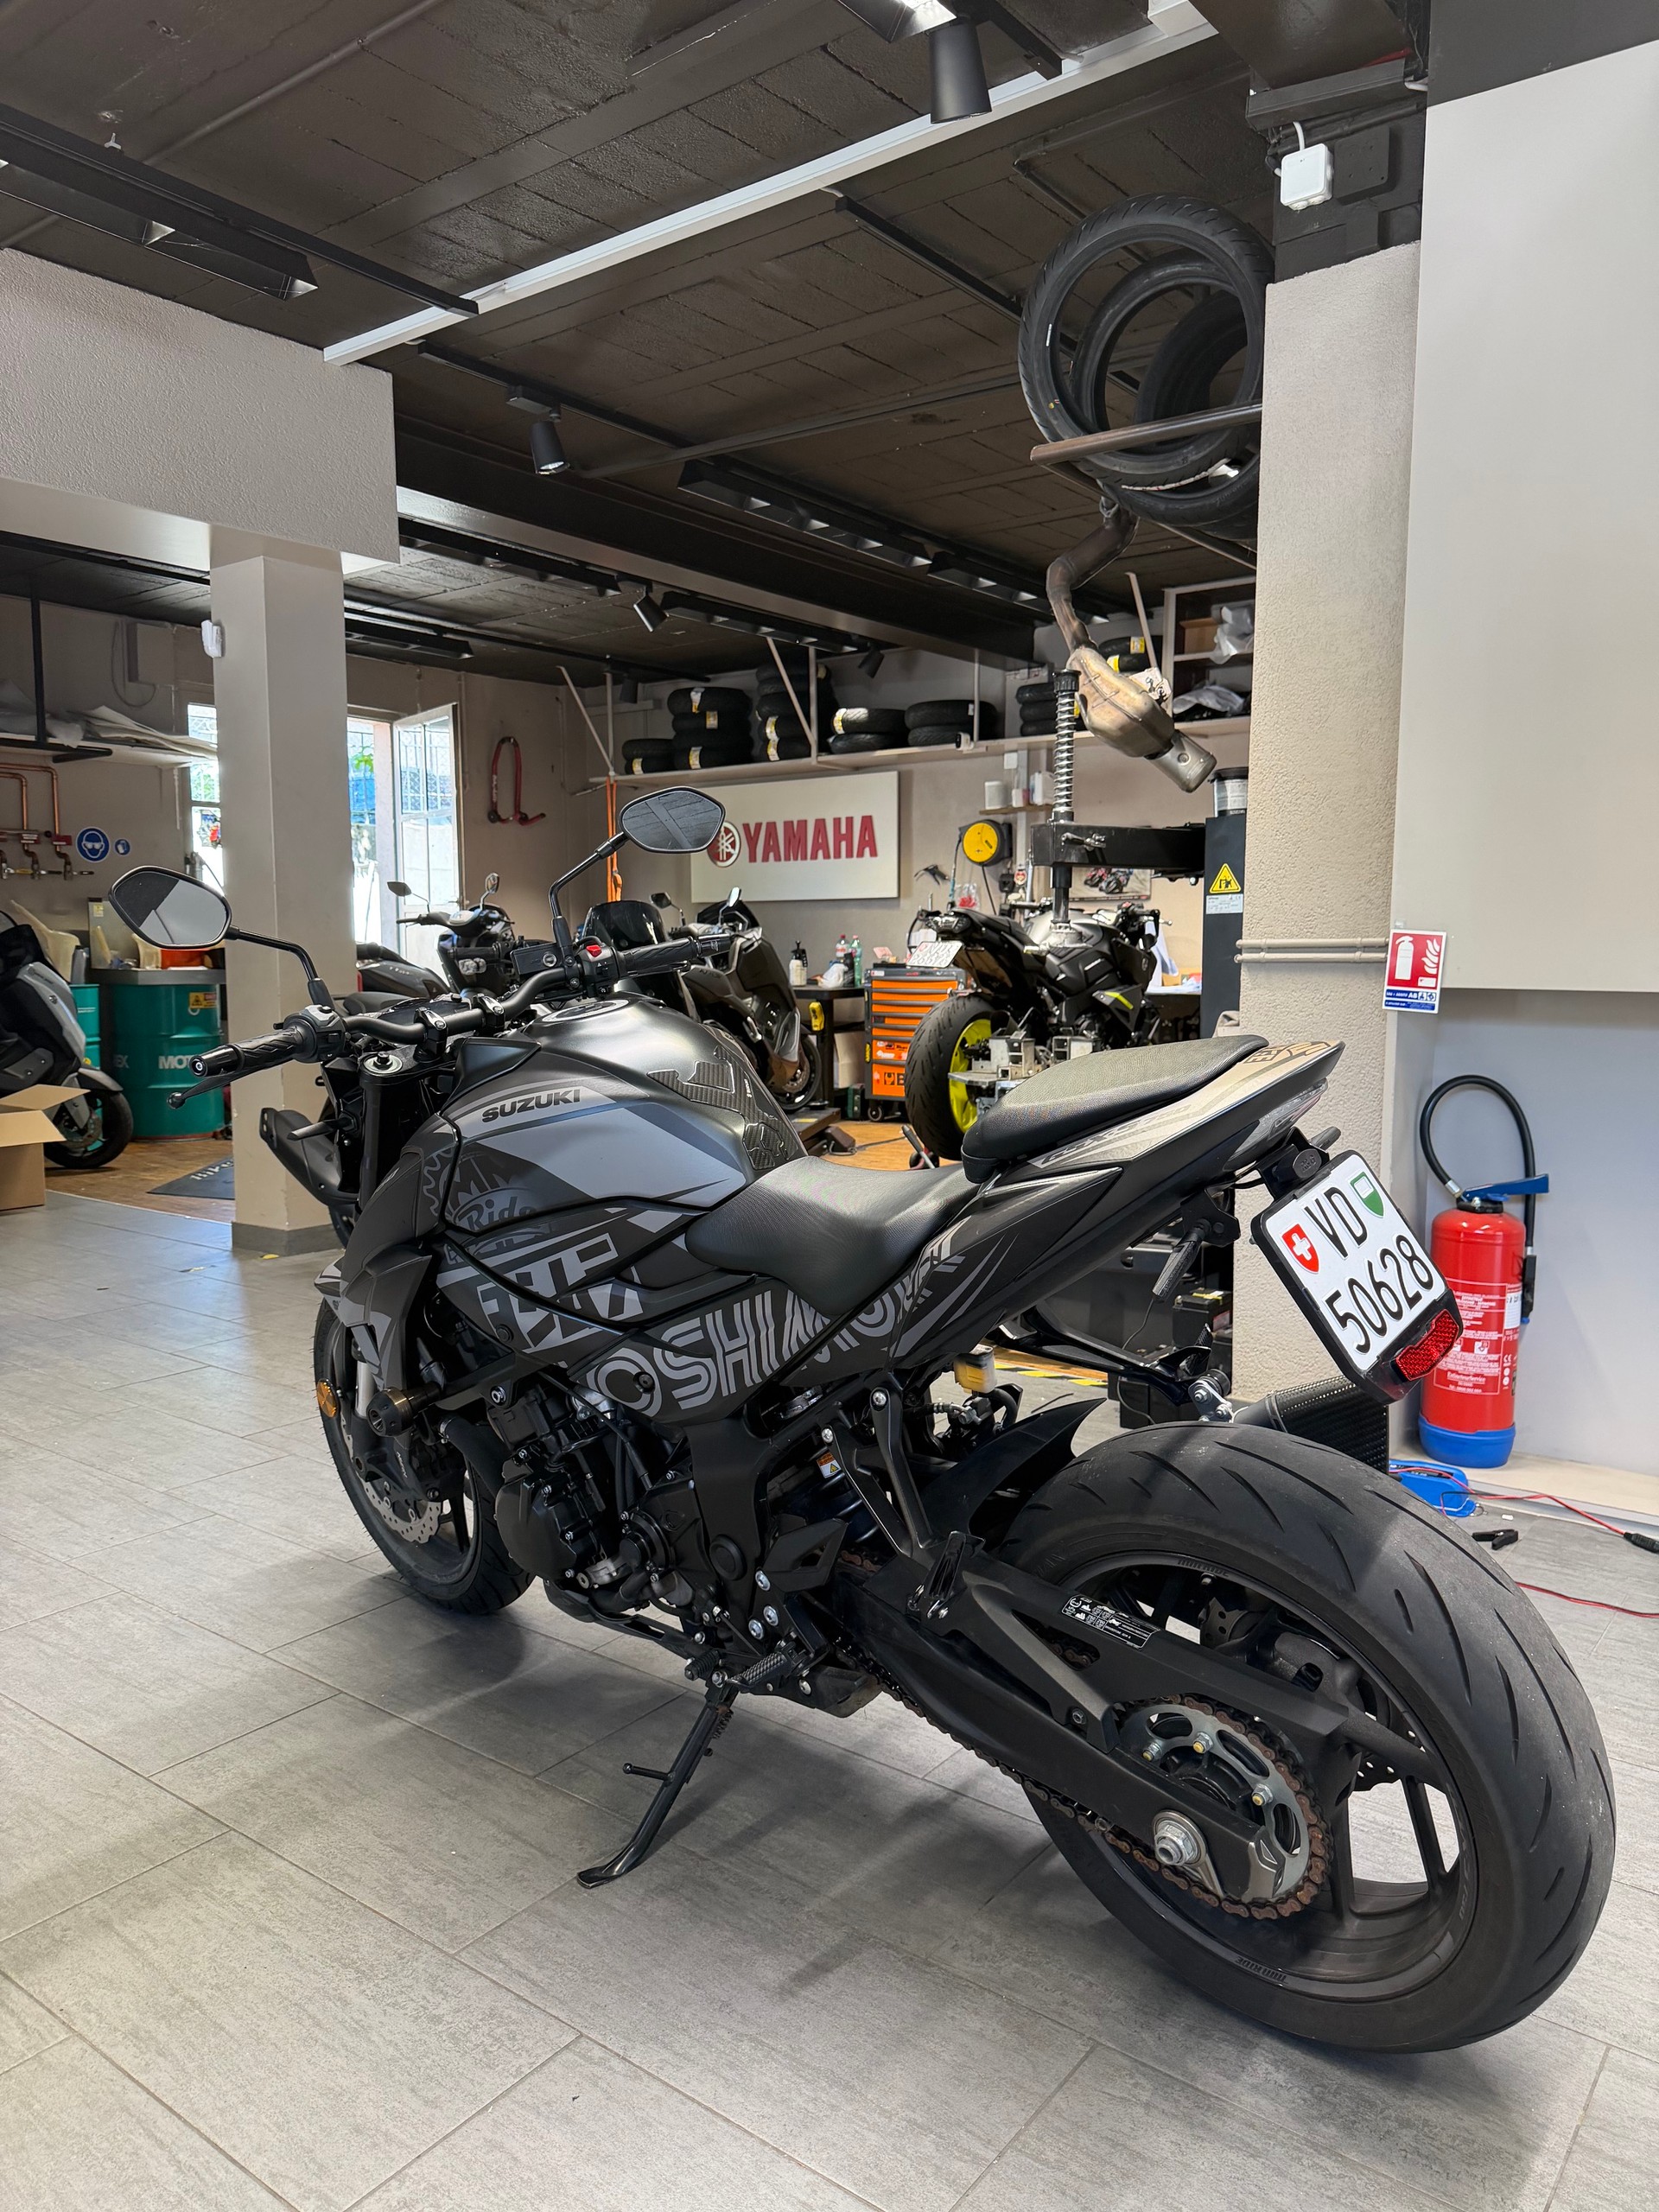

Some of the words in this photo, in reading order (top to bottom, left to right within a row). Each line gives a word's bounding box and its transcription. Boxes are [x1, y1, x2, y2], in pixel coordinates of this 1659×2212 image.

[741, 815, 878, 863] YAMAHA
[482, 1089, 581, 1123] SUZUKI
[1304, 1186, 1368, 1259] VD
[1325, 1234, 1434, 1355] 50628
